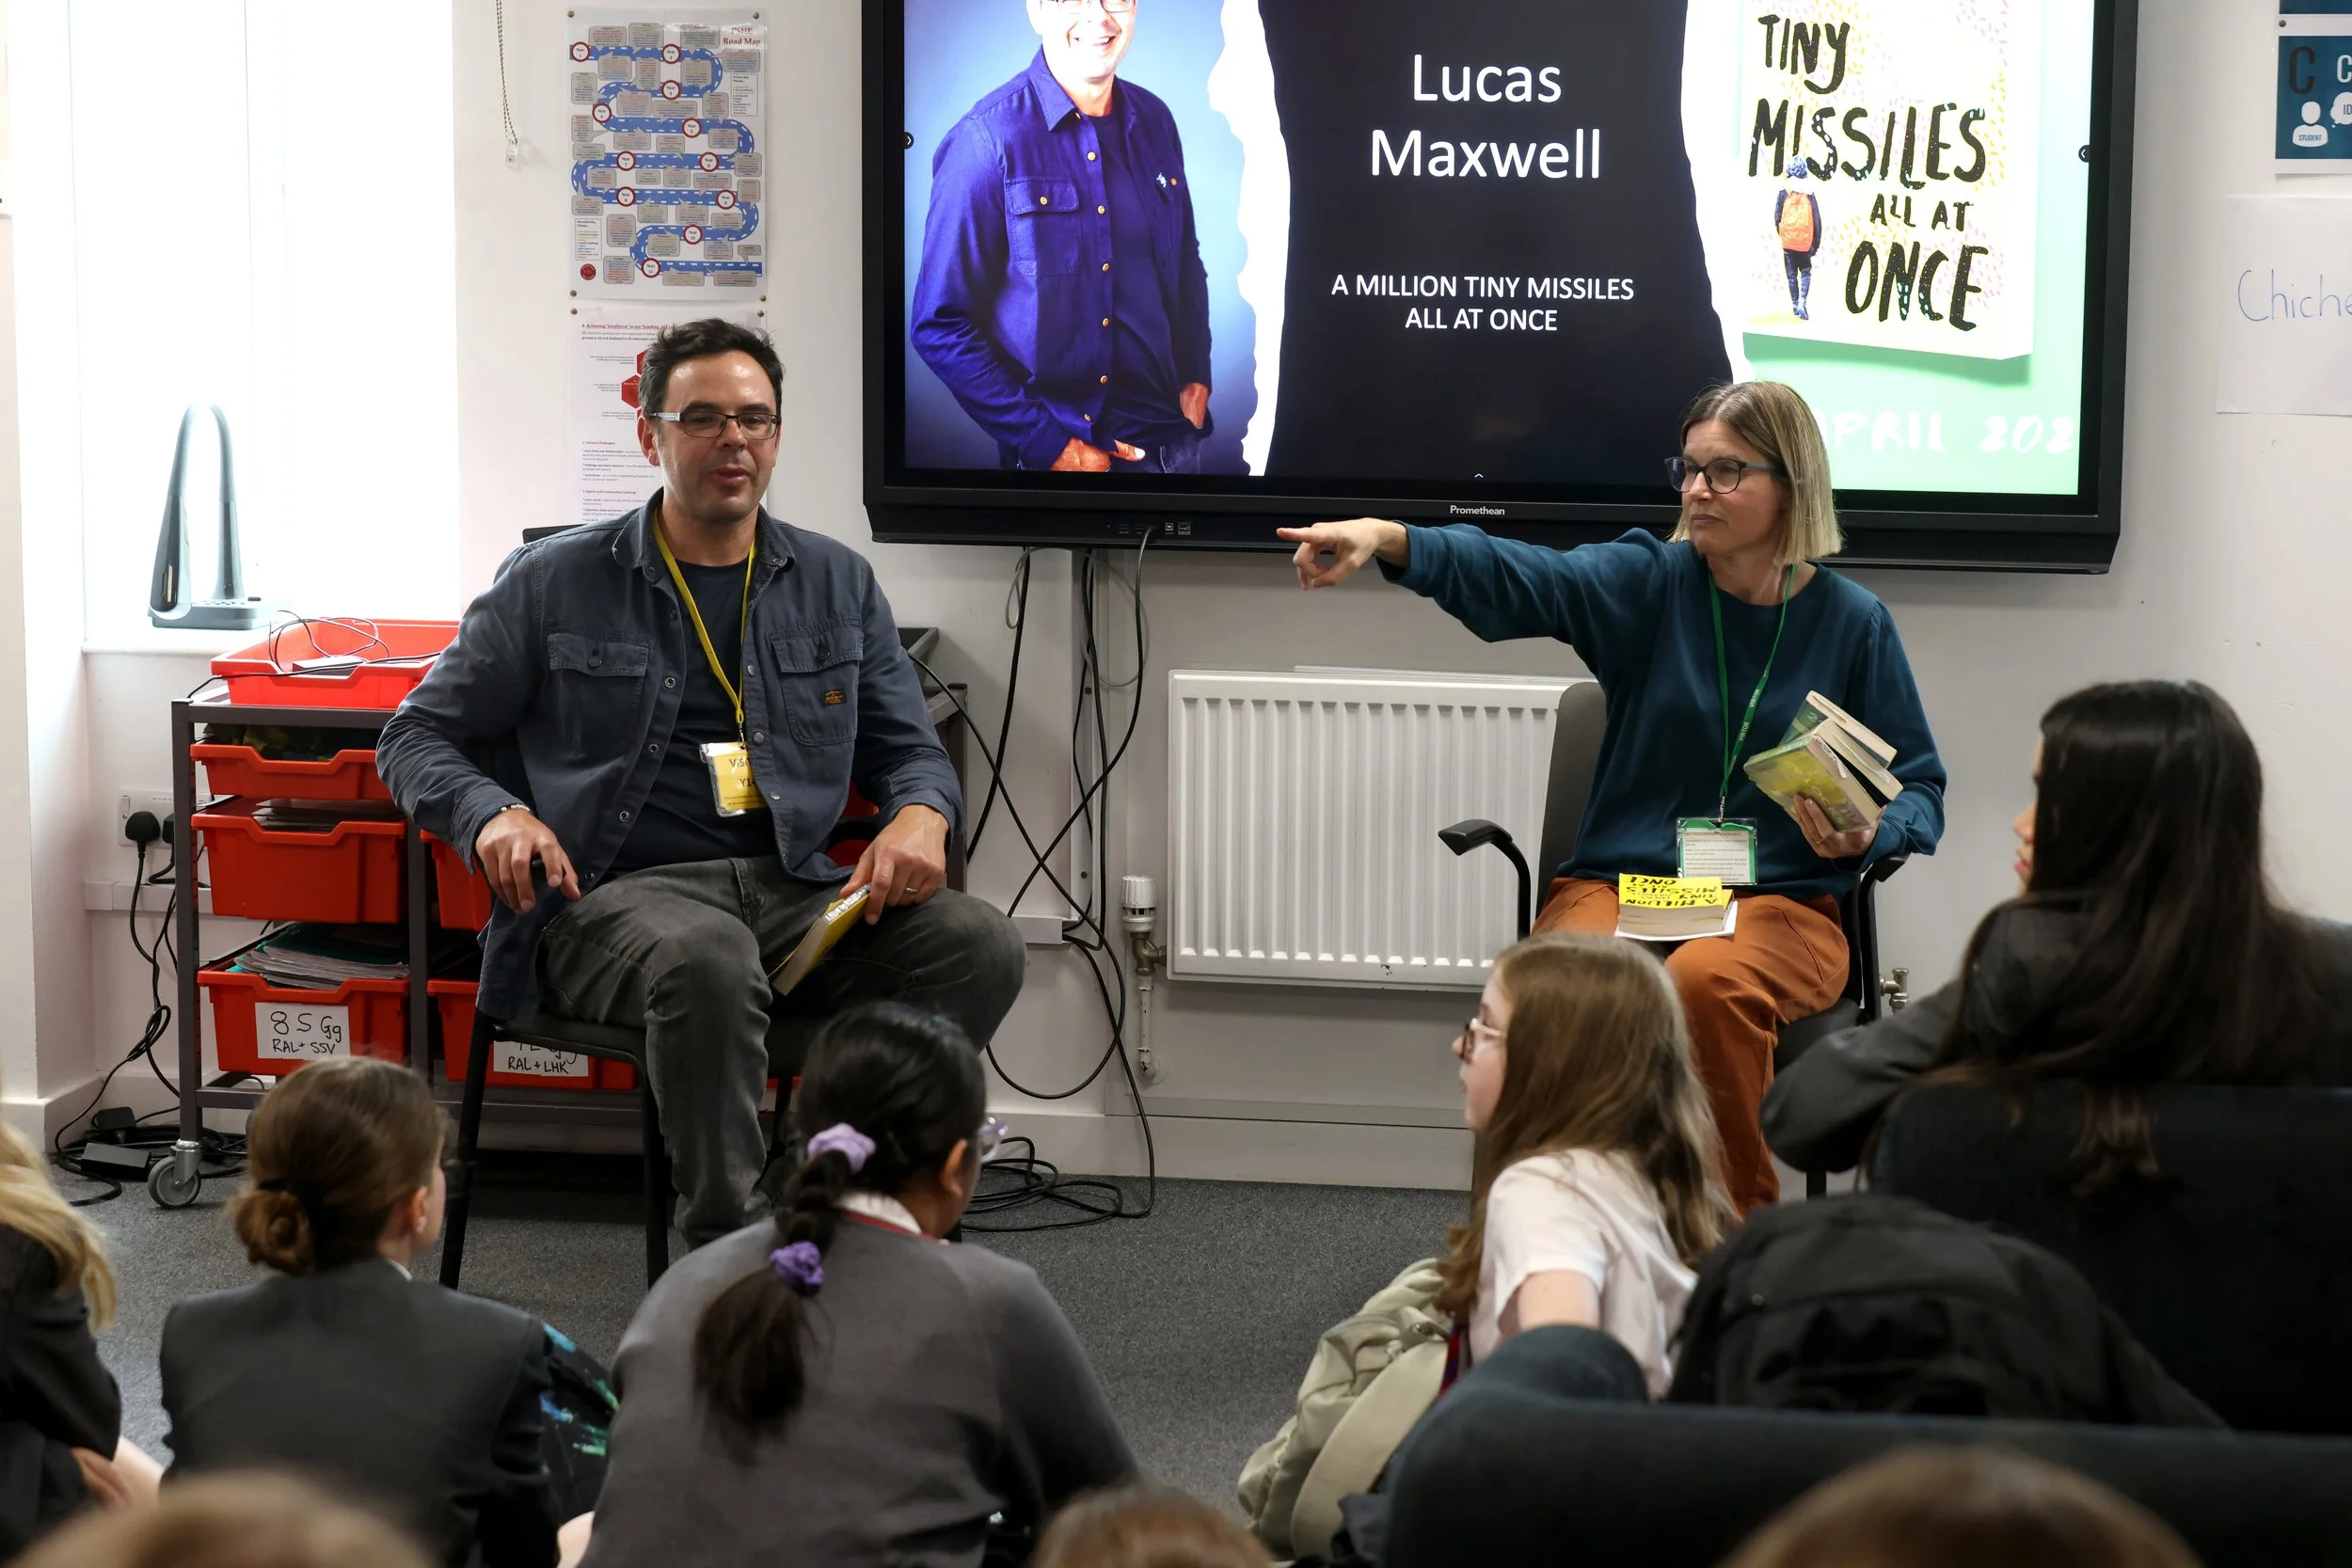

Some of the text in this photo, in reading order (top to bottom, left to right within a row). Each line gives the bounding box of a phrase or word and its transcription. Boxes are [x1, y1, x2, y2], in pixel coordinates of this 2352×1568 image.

[1758, 15, 1851, 94] TINY
[1413, 54, 1562, 103] Lucas
[2289, 45, 2315, 95] C
[1749, 97, 1987, 190] MISSILES
[2298, 134, 2322, 142] STUDENT
[1372, 128, 1600, 179] Maxwell
[1869, 193, 1974, 231] ALL AT
[1331, 275, 1634, 301] A MILLION TINY MISSILES
[1845, 240, 1989, 332] ONCE
[1406, 308, 1558, 331] ALL AT ONCE
[1450, 504, 1505, 515] Promethean
[1749, 689, 1761, 708] VISITOR
[1738, 721, 1751, 741] VISITOR
[270, 1010, 290, 1036] 8
[310, 1041, 336, 1054] SSV
[508, 1055, 532, 1071] RAL
[544, 1061, 569, 1074] LHK
